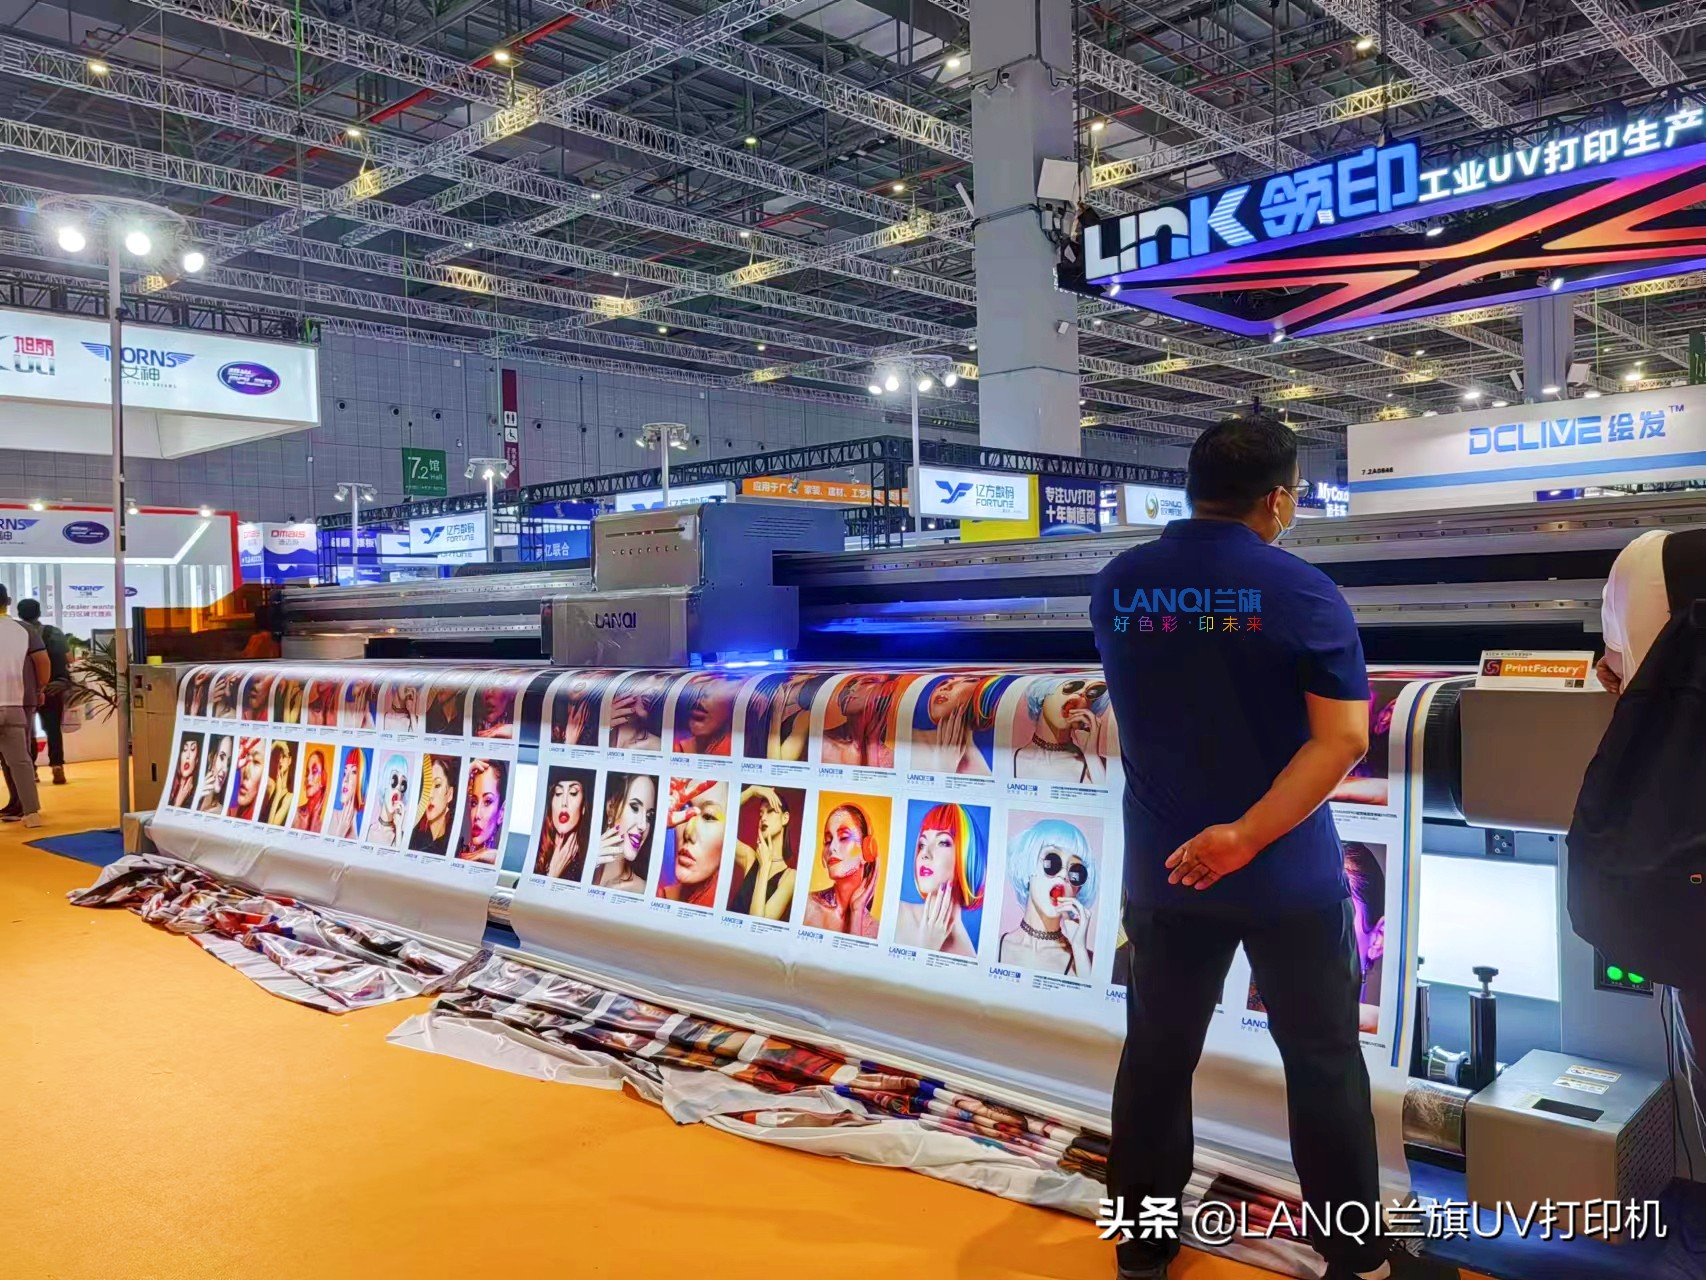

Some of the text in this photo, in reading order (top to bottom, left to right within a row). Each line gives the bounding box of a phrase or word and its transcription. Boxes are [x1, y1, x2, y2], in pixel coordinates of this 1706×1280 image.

[1259, 142, 1419, 239] 领印
[1419, 108, 1705, 202] 工业UV打印生产
[1469, 416, 1601, 455] DCLIVE
[1608, 410, 1666, 442] 绘发
[408, 456, 440, 479] 7.2 馆
[976, 484, 1014, 499] 亿方数码
[1045, 486, 1096, 505] 专注UV打印
[975, 498, 1014, 508] FORTUNE
[1045, 505, 1096, 525] 十年制造商
[446, 523, 475, 535] 亿方数码
[446, 534, 475, 542] FORTUNE
[1113, 587, 1262, 613] LANQI兰旗
[595, 612, 637, 629] LANQI
[1504, 663, 1579, 677] PrintFactory
